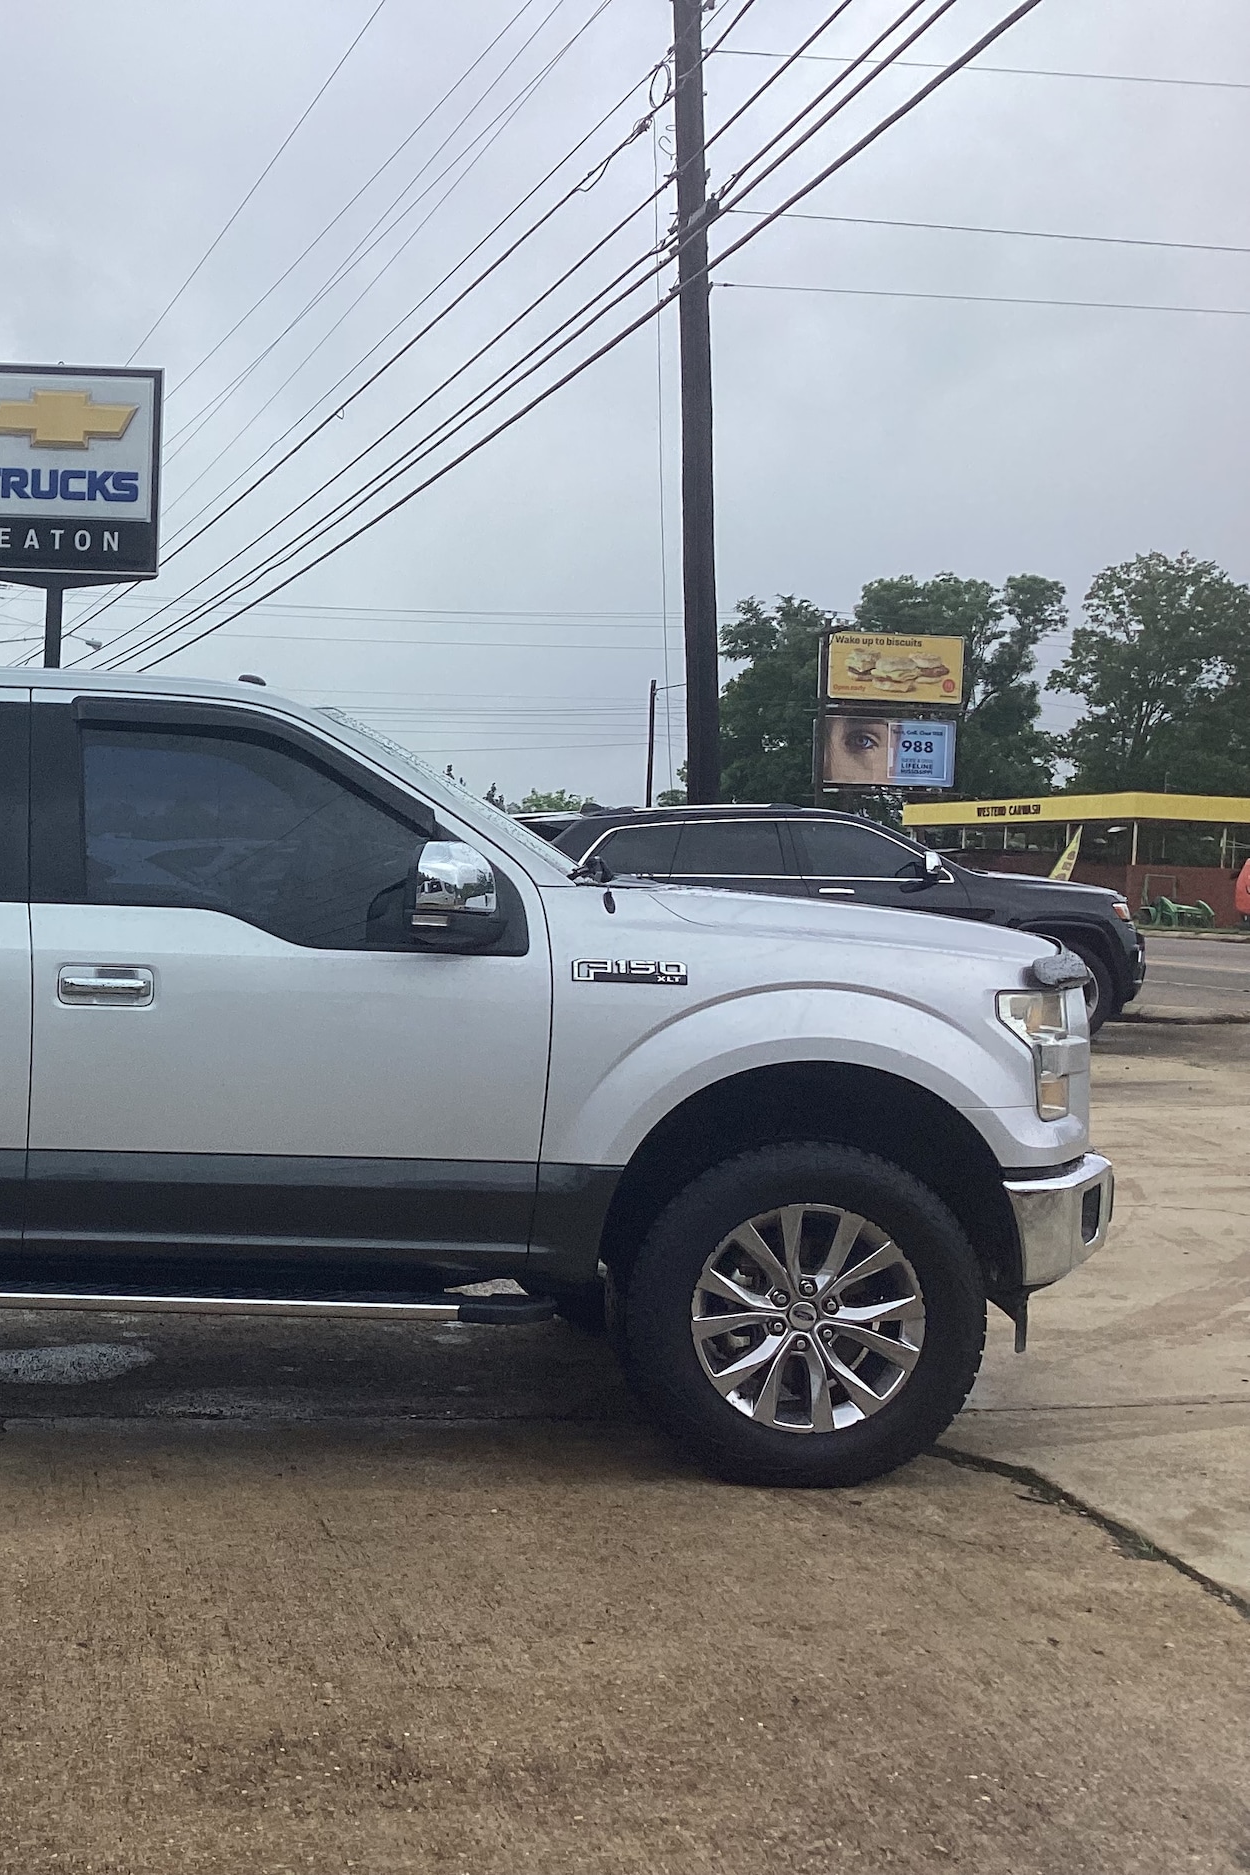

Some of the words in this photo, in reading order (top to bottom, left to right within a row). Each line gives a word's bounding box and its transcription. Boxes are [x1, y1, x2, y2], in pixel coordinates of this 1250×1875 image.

[835, 635, 861, 645] Wake
[862, 637, 874, 647] up
[875, 638, 885, 646] to
[886, 637, 922, 648] biscuits
[901, 740, 934, 753] 988
[657, 975, 681, 983] XLT
